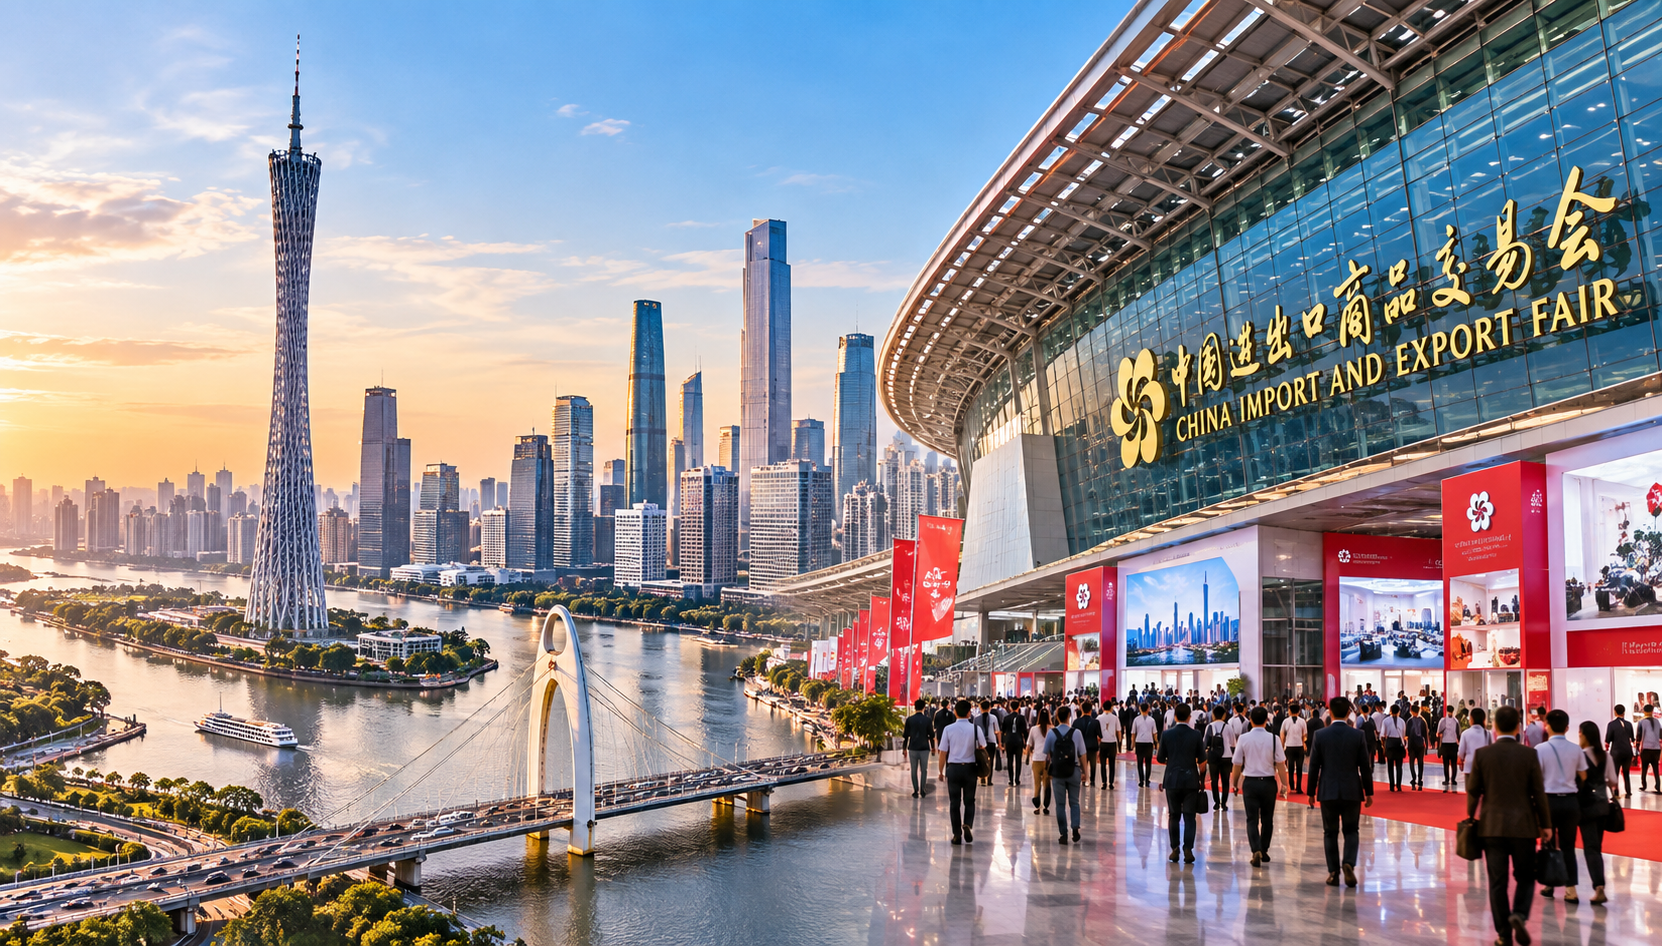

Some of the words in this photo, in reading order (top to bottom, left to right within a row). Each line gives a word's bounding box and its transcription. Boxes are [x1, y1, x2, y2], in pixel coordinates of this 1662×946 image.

[1176, 401, 1233, 442] CHINA
[1239, 370, 1322, 424] IMPORT
[1329, 352, 1384, 397] AND
[1395, 307, 1516, 377] EXPORT
[1531, 278, 1619, 338] FAIR
